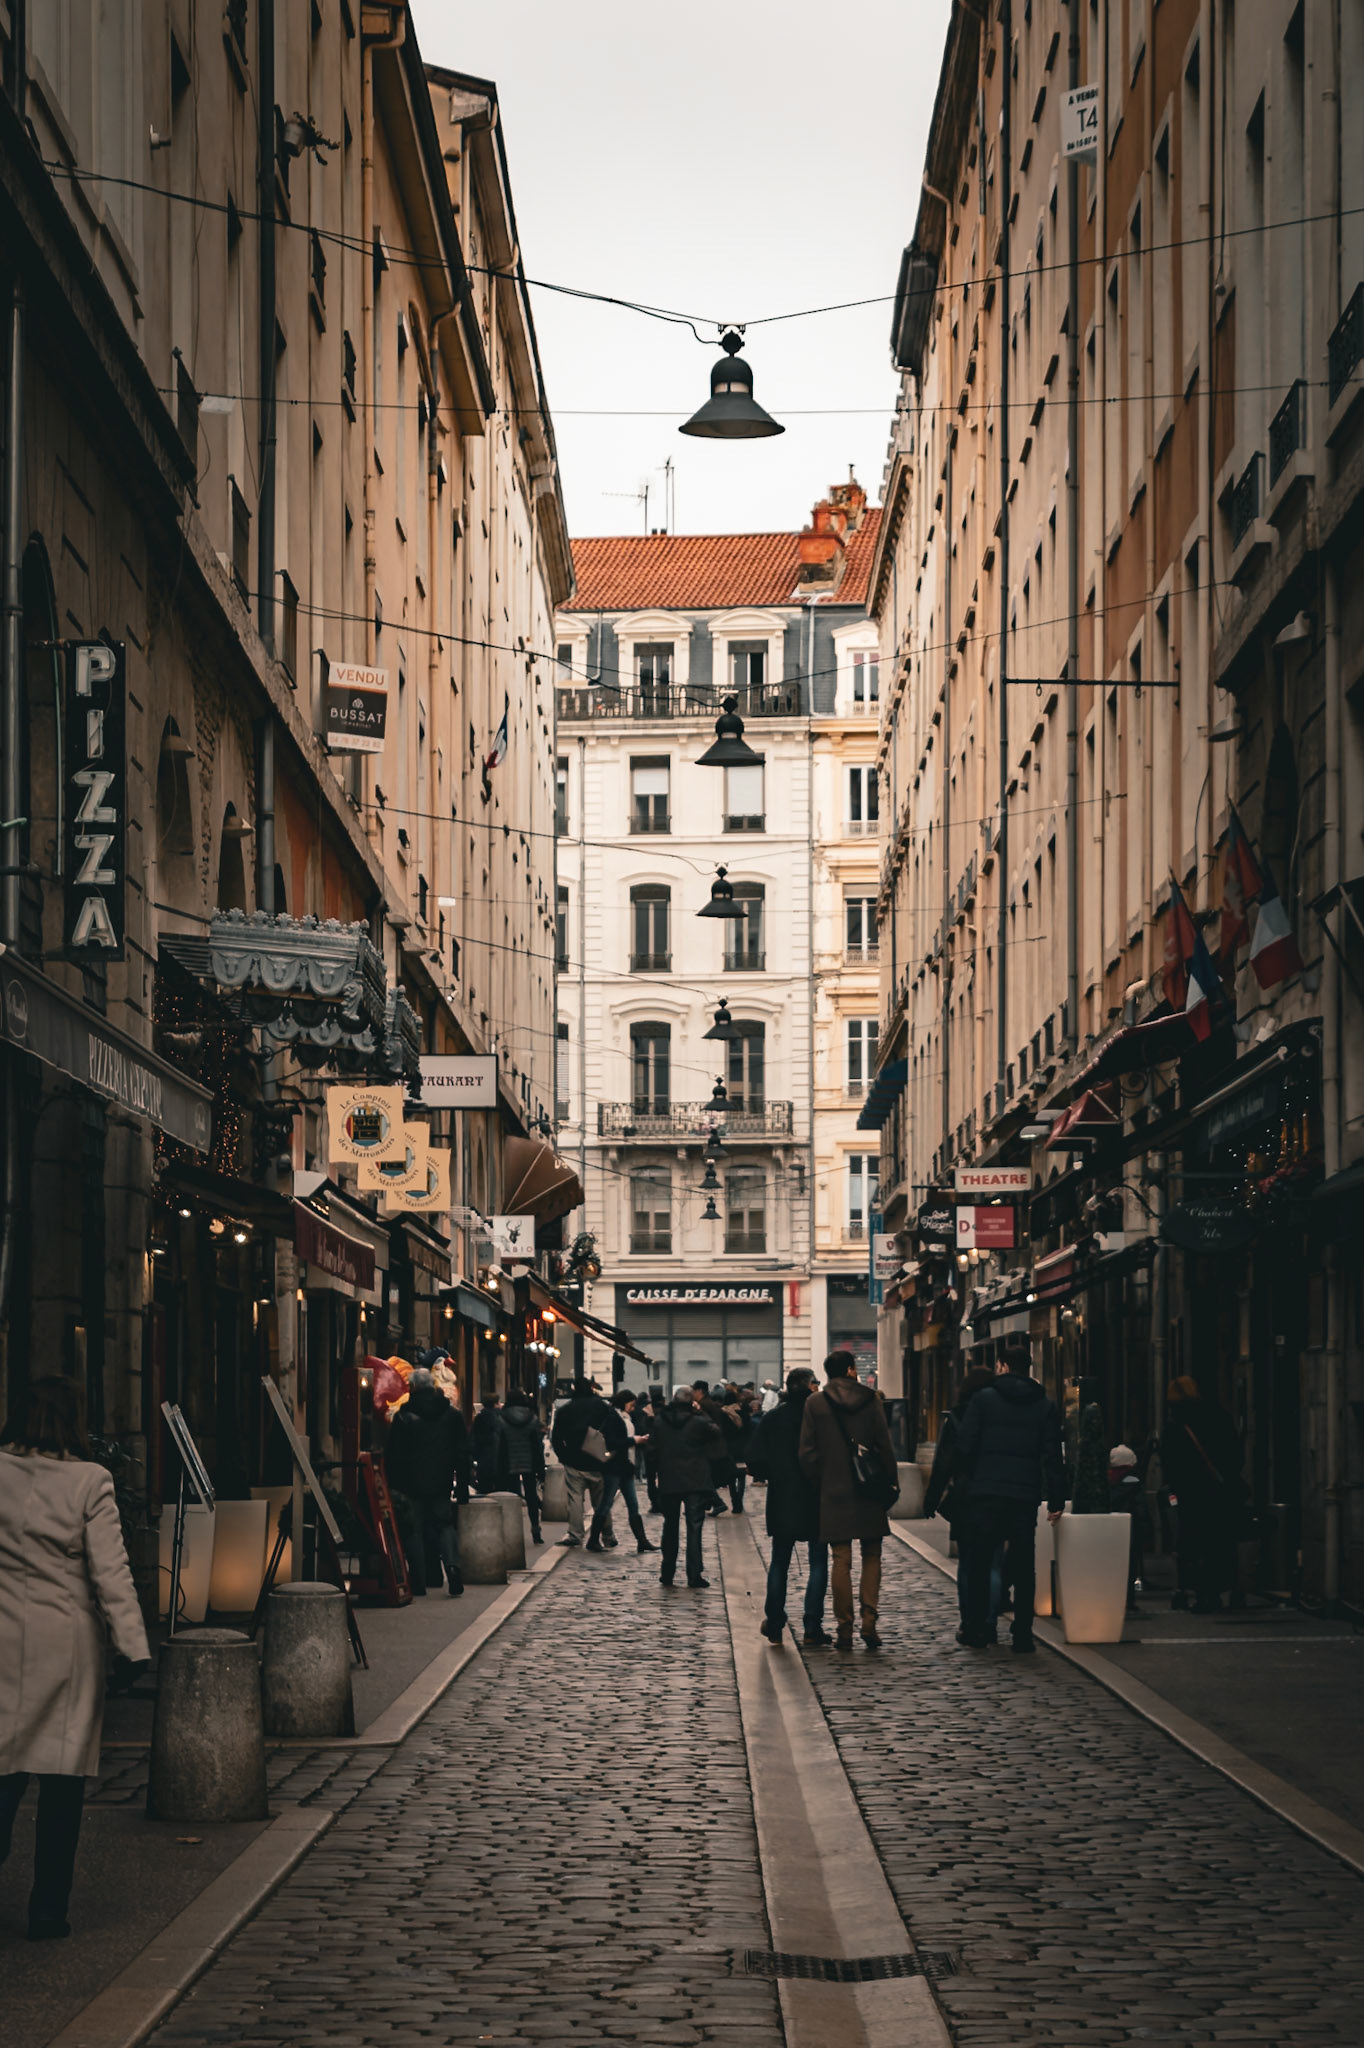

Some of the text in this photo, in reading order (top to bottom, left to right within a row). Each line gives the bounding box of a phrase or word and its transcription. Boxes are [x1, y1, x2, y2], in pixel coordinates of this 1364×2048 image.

[1077, 105, 1097, 132] T4
[336, 668, 385, 686] VENDU
[330, 707, 384, 724] BUSSAT
[72, 645, 119, 948] PIZZA
[88, 1031, 128, 1102] PIZZERIA
[340, 1093, 392, 1110] Le Comptoir
[338, 1137, 349, 1151] des
[351, 1137, 395, 1158] Marronniers
[961, 1174, 1028, 1185] THEATRE
[627, 1288, 769, 1300] CAISSE D'EPARGNE
